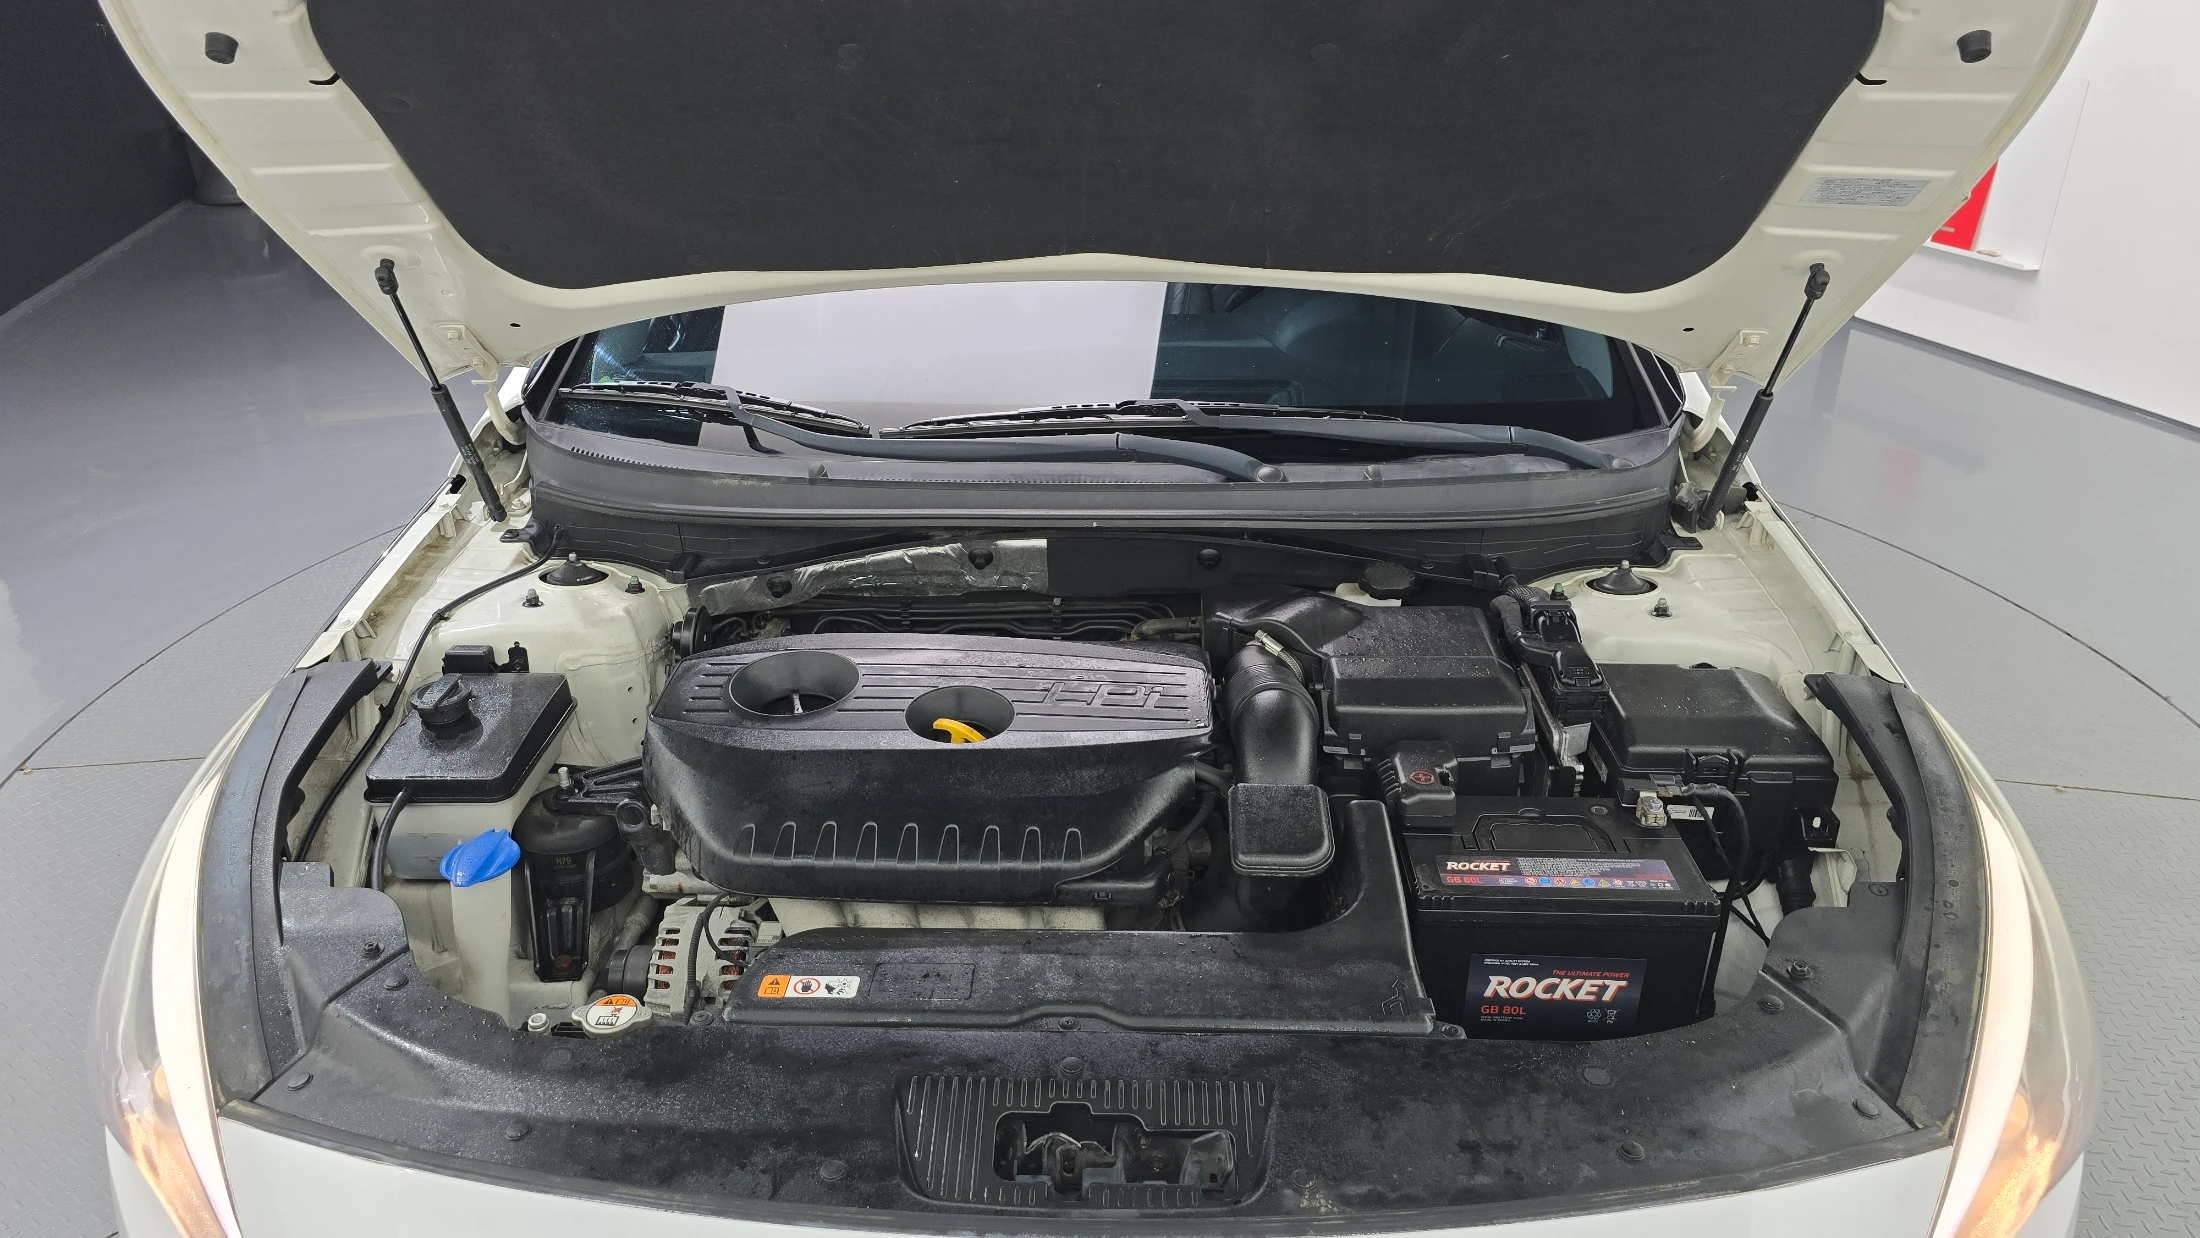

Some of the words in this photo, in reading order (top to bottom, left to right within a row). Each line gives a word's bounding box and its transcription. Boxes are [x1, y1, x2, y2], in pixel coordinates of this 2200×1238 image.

[1446, 861, 1511, 871] ROCKET
[1483, 975, 1629, 1002] ROCKET
[1481, 1005, 1499, 1014] GB
[1502, 1005, 1526, 1015] 80L
